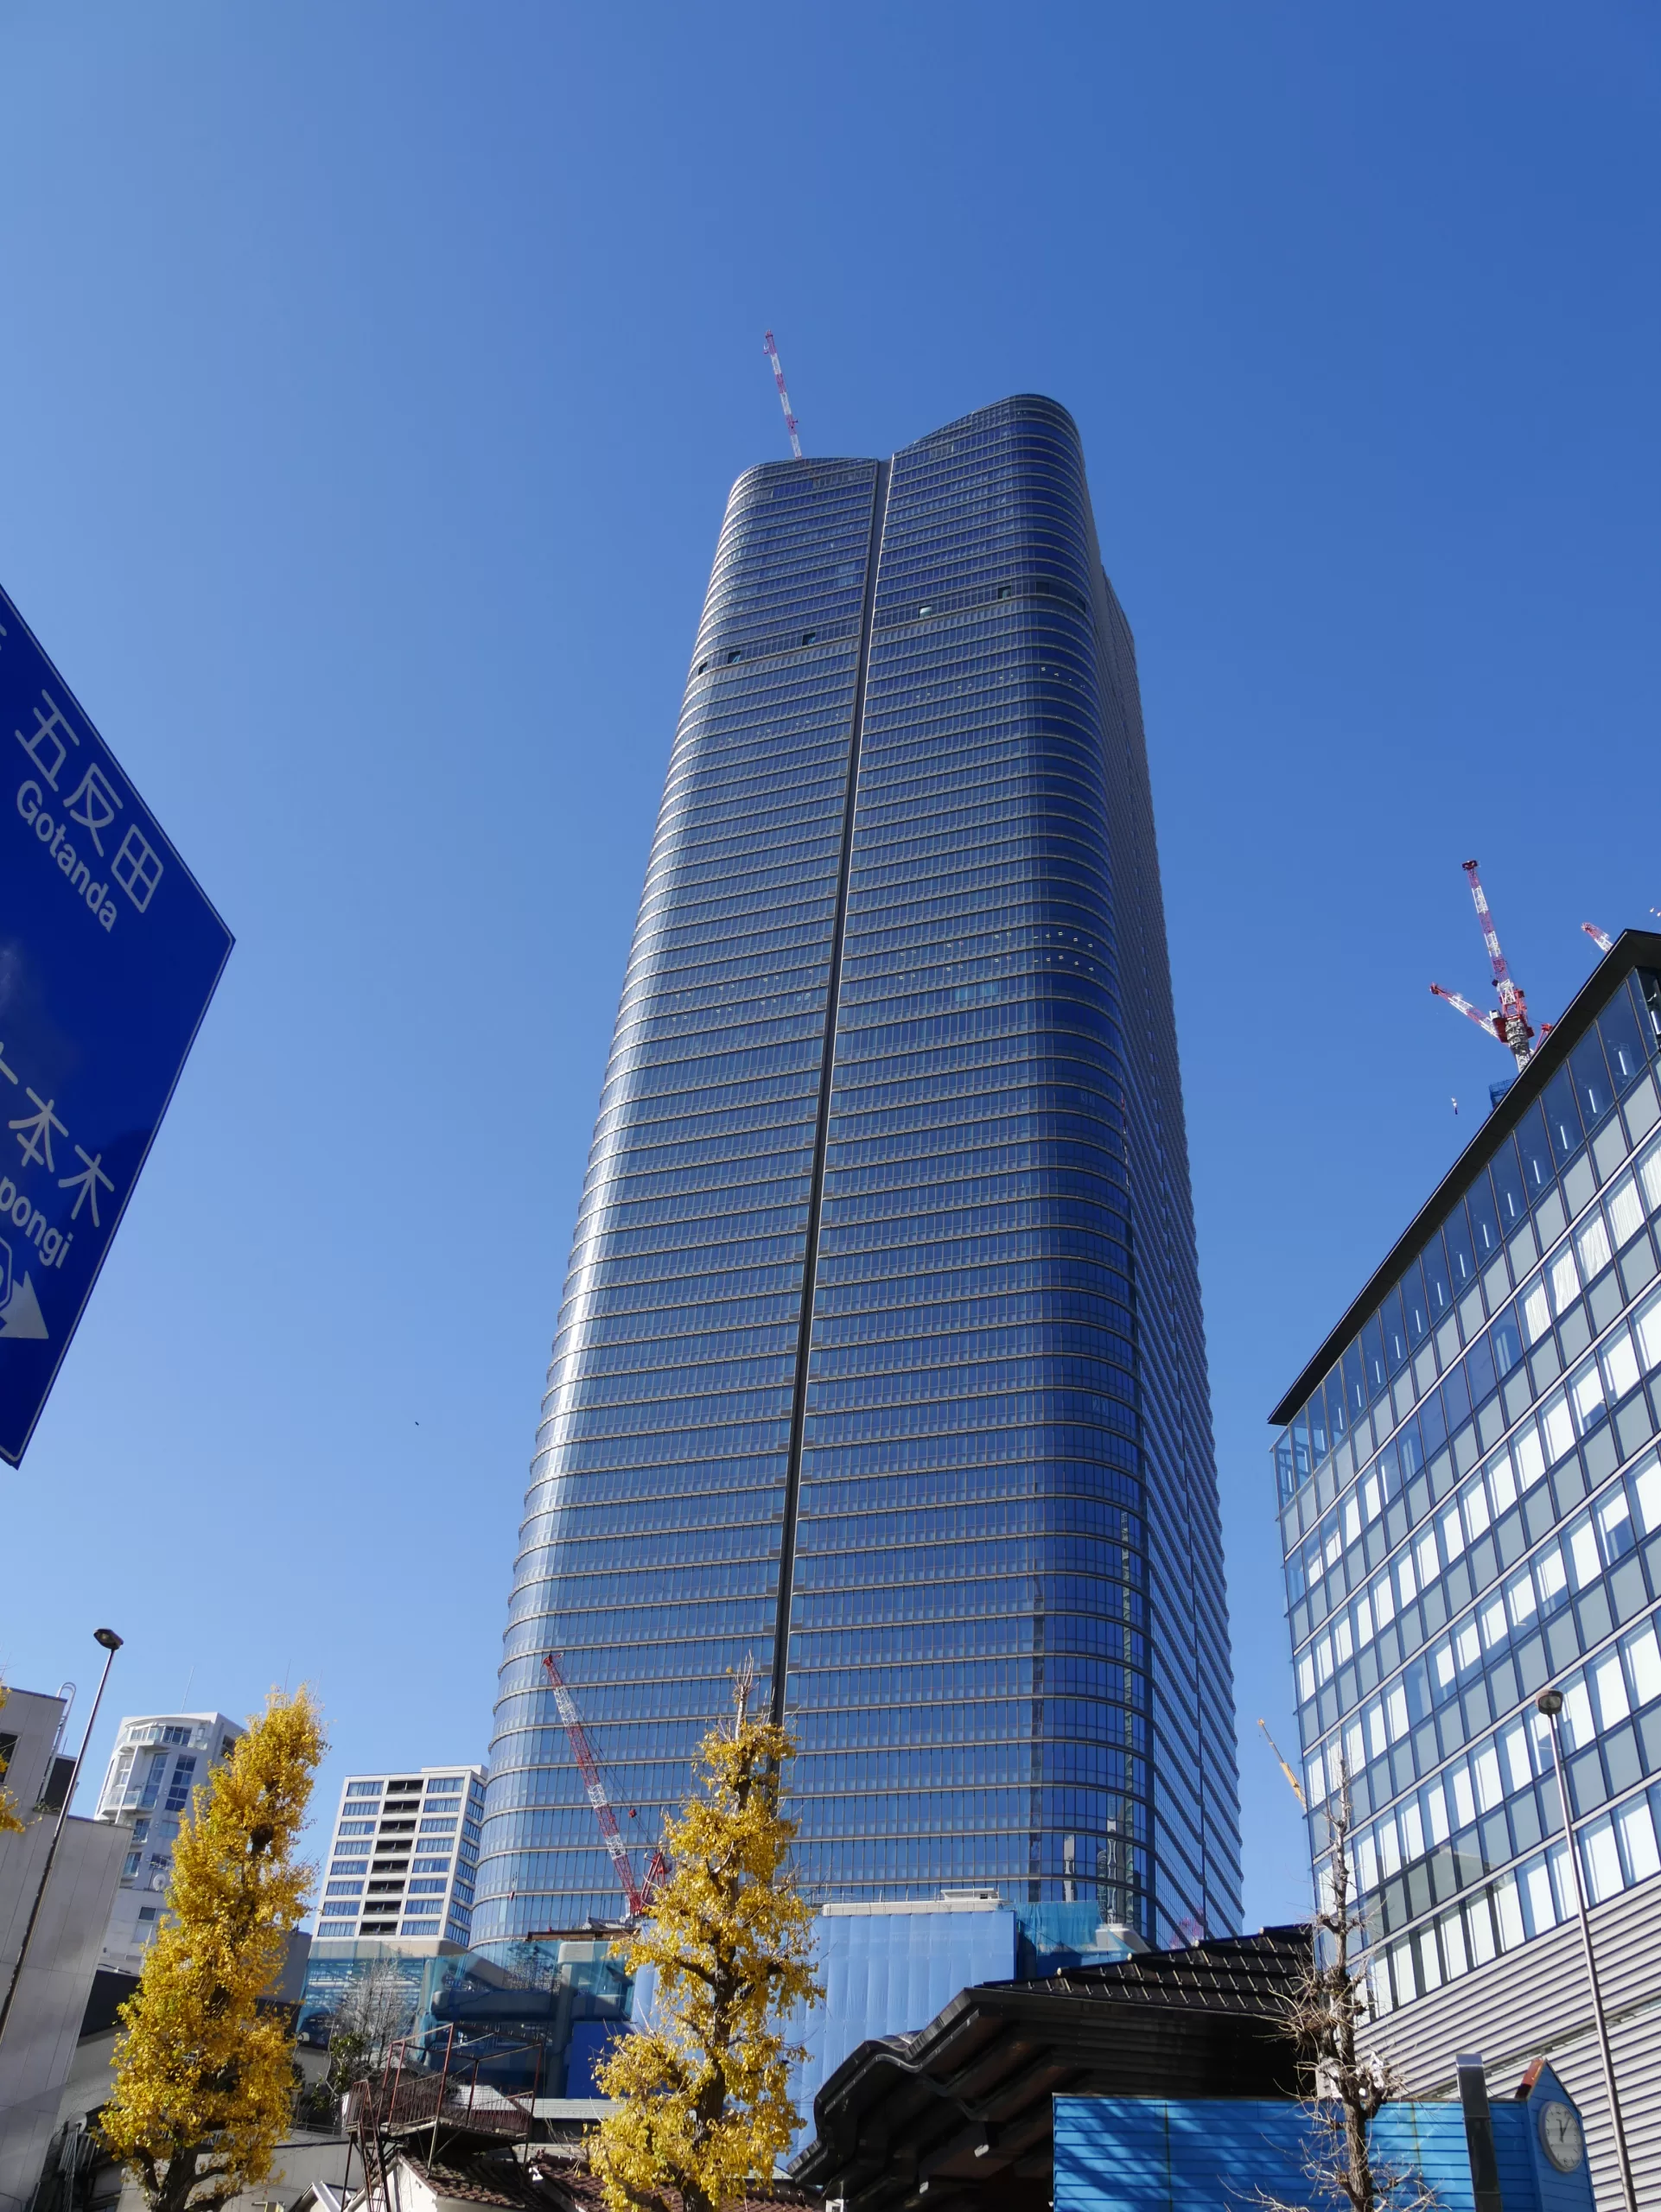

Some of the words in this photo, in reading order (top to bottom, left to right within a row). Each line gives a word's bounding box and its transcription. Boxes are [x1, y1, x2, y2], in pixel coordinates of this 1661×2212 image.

[16, 689, 164, 913] 五反田
[16, 779, 118, 933] Gotanda
[0, 1041, 115, 1228] 本木
